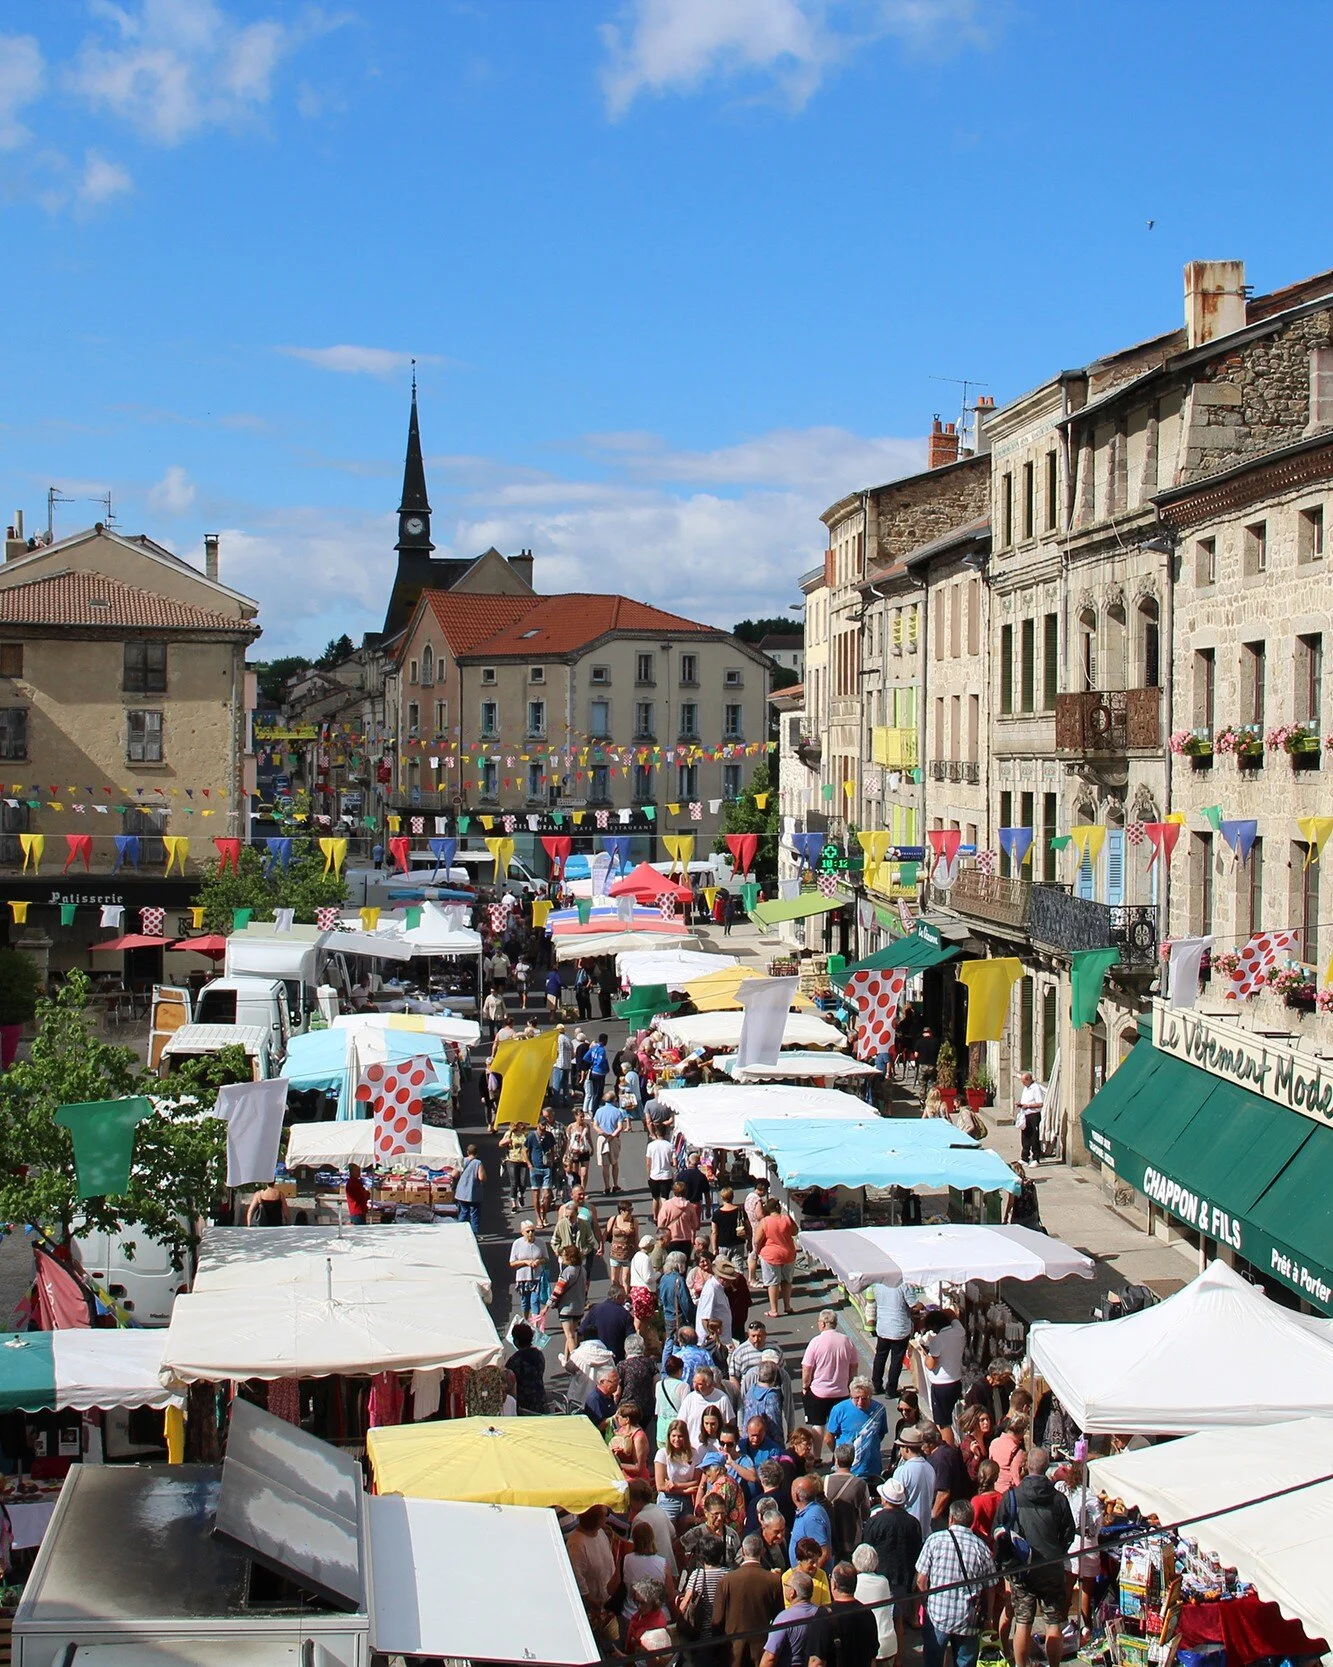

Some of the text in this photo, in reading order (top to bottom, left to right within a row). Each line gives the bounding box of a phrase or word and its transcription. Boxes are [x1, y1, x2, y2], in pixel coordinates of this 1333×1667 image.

[514, 823, 563, 831] RESURANT
[48, 892, 123, 904] Patisserie
[1159, 1007, 1180, 1049] Le
[1183, 1015, 1271, 1095] Vêtement
[1143, 1166, 1241, 1250] CHAPPON & FILS
[1270, 1247, 1332, 1304] Prêt à Porter
